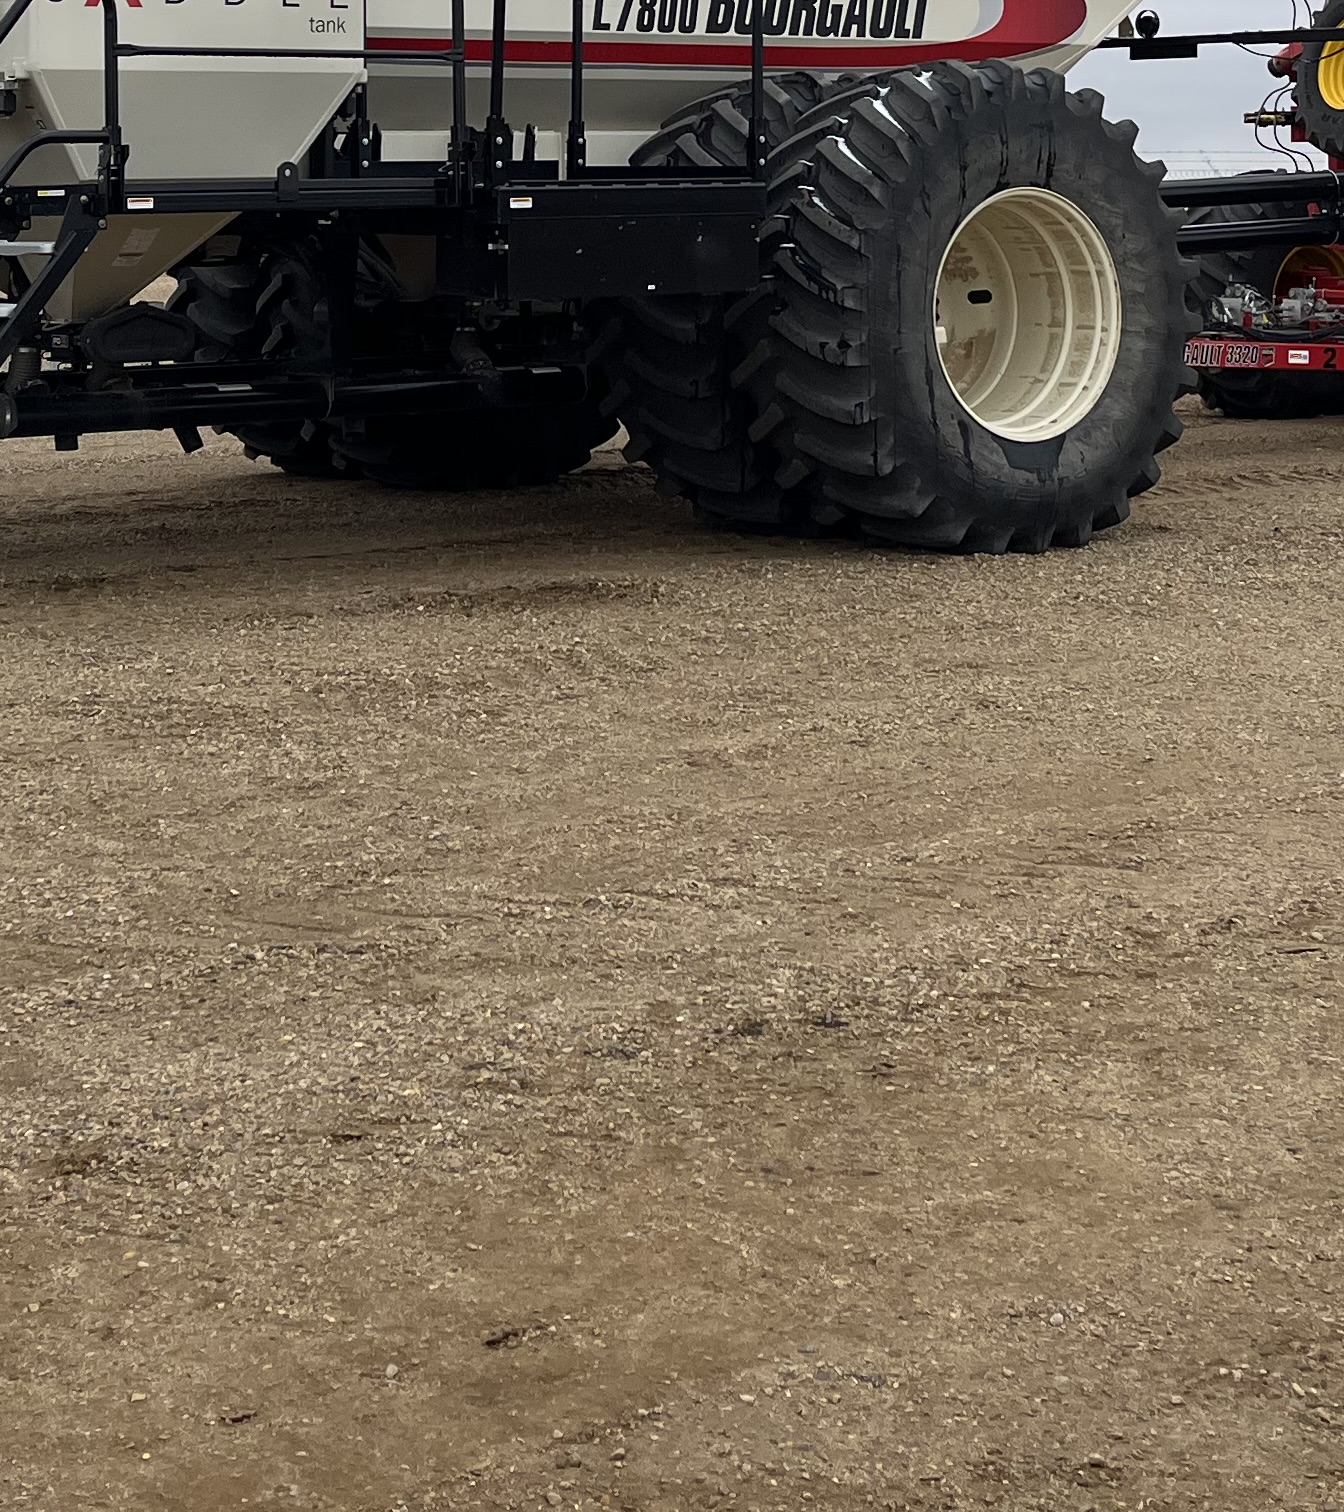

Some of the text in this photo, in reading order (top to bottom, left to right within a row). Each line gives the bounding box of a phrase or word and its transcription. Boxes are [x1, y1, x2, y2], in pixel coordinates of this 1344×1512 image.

[308, 16, 347, 34] tank
[1225, 343, 1260, 365] 3320
[1323, 347, 1337, 369] 2
